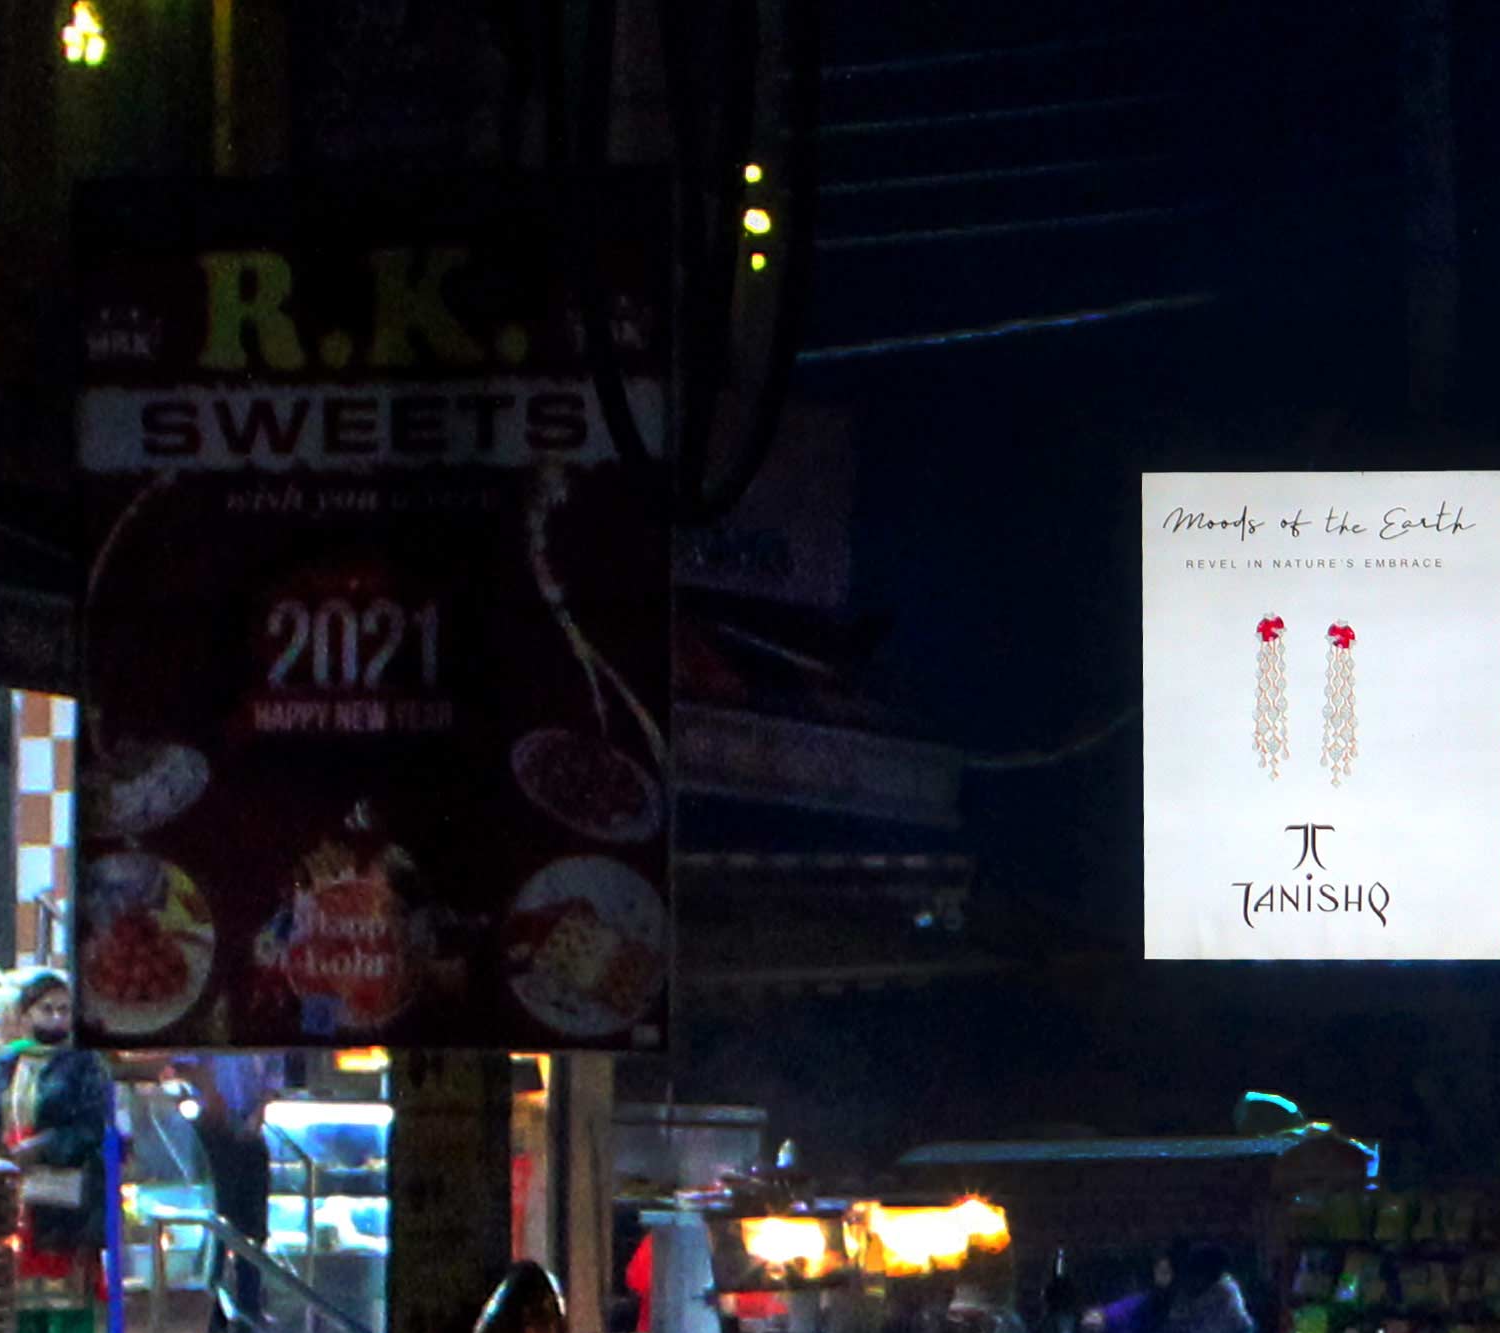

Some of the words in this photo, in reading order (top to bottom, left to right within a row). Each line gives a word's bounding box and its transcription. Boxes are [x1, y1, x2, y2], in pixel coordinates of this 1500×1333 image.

[196, 247, 532, 370] R.K.
[141, 392, 588, 456] SWEETS
[1162, 505, 1265, 541] Moods
[1280, 508, 1313, 538] of
[1324, 505, 1367, 535] the
[1378, 500, 1477, 540] Earth
[1185, 559, 1238, 569] REVEL
[1247, 559, 1264, 569] IN
[1272, 558, 1356, 569] NATURE'S
[1363, 558, 1444, 569] EMBRACE
[264, 592, 441, 690] 2021
[253, 698, 329, 732] HAPPY
[334, 698, 387, 732] NEW
[393, 698, 454, 732] YEAR
